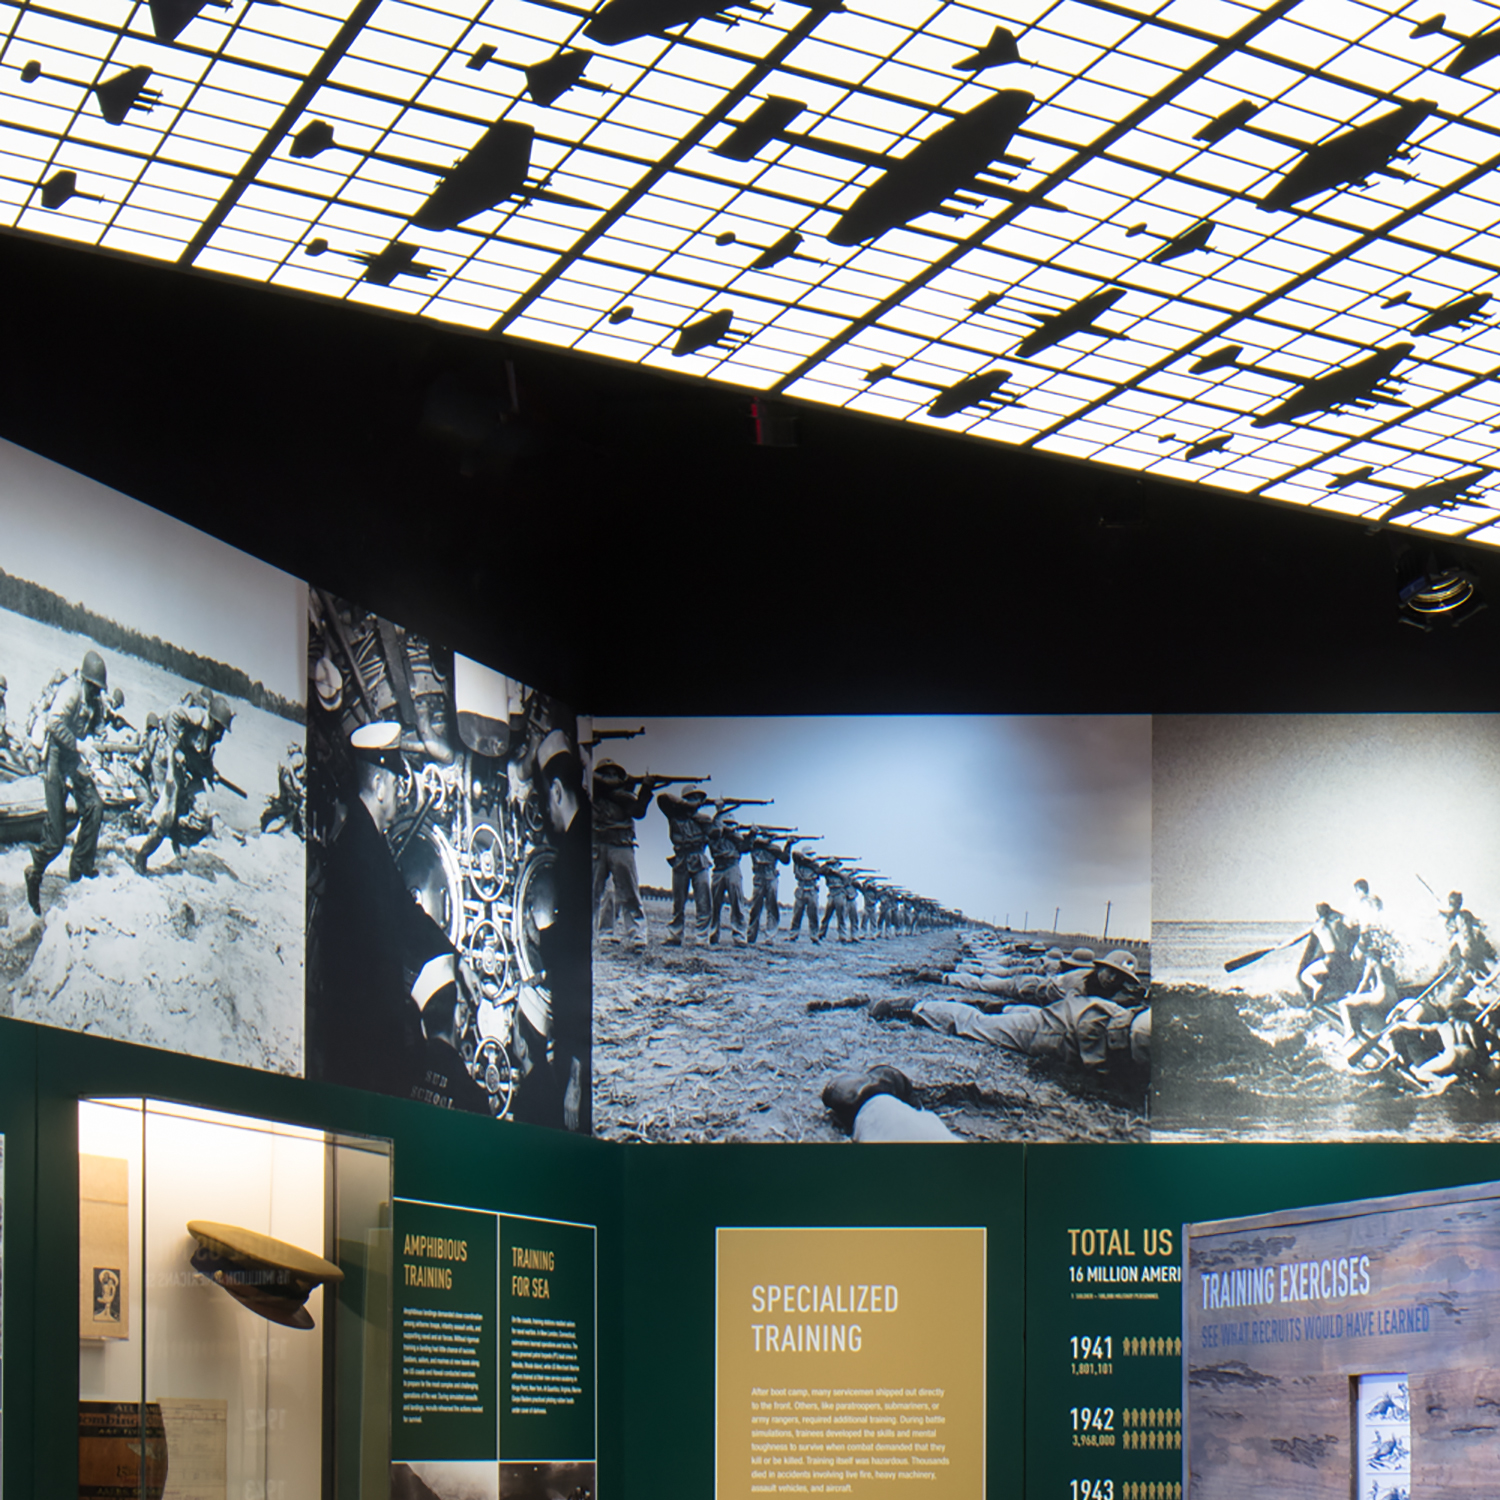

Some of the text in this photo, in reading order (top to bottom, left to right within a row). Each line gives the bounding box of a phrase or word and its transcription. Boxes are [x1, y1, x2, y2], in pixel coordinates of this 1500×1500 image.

[410, 1085, 456, 1110] SCHOOL
[403, 1233, 468, 1262] AMPHIBIOUS
[1067, 1228, 1173, 1256] TOTAL US
[511, 1246, 555, 1271] TRAINING
[403, 1264, 453, 1290] TRAINING
[1069, 1265, 1181, 1283] 16 MILLION AMERI
[1200, 1255, 1371, 1311] TRAINING EXERCISES
[511, 1275, 550, 1299] FOR SEA
[751, 1285, 899, 1314] SPECIALIZED
[751, 1324, 864, 1353] TRAINING
[1201, 1304, 1430, 1349] SEE WHAT RECRUITS WOULD HAVE LEARNED
[1070, 1335, 1112, 1360] 1941
[750, 1387, 768, 1395] After
[769, 1388, 787, 1396] boot
[786, 1388, 810, 1397] camp,
[810, 1389, 831, 1397] many
[875, 1388, 904, 1397] shipped
[904, 1388, 916, 1396] out
[918, 1388, 944, 1397] directly
[759, 1401, 772, 1409] the
[773, 1401, 793, 1409] front.
[793, 1401, 820, 1410] Others,
[820, 1401, 834, 1409] like
[834, 1402, 883, 1411] paratroopers,
[884, 1401, 930, 1409] submariners,
[1070, 1407, 1114, 1431] 1942
[750, 1484, 853, 1492] assault vehicles, and aircraft.
